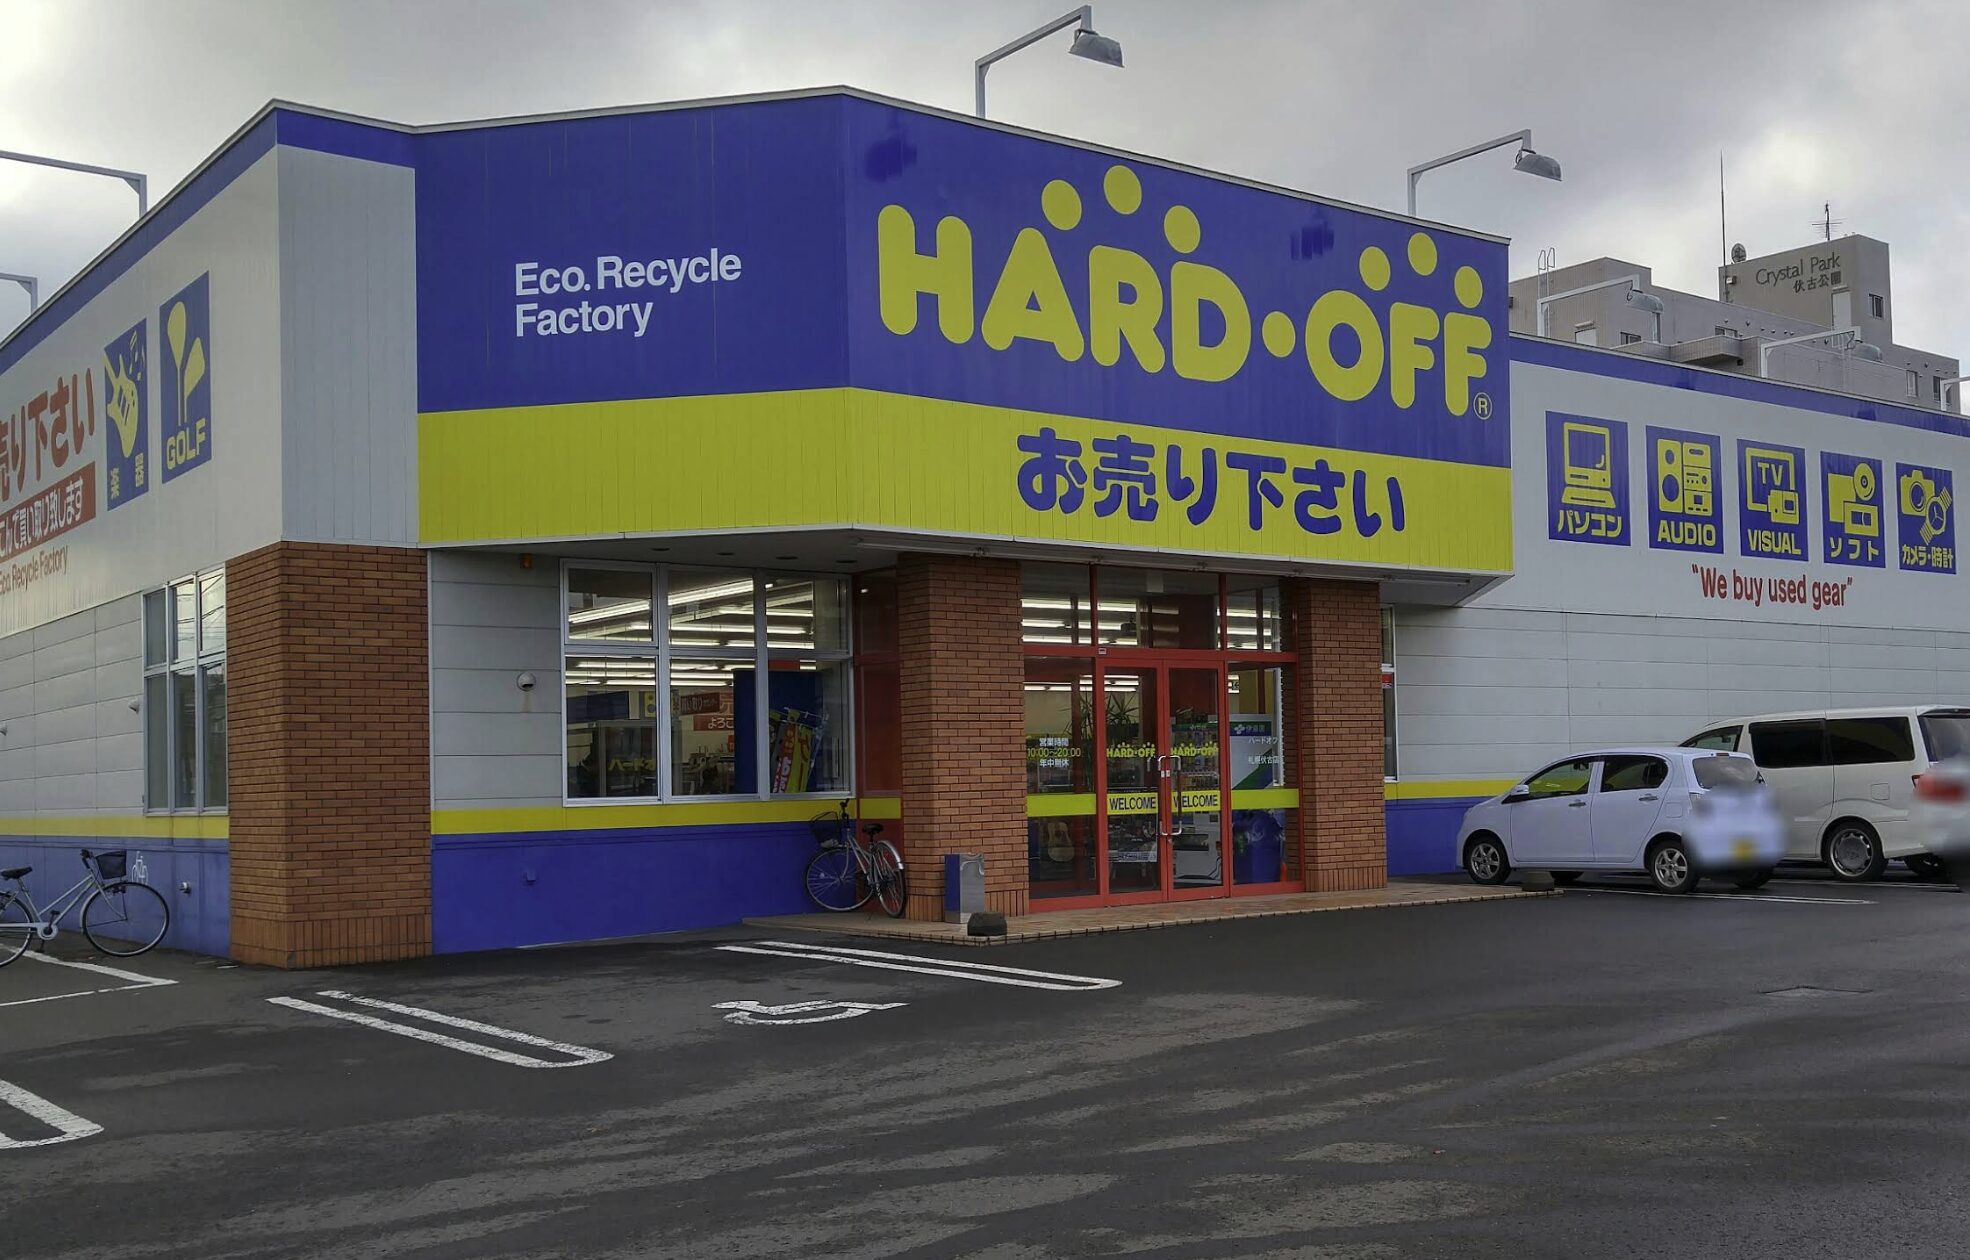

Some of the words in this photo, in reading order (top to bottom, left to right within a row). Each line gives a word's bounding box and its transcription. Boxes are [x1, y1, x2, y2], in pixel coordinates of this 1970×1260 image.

[515, 262, 591, 296] Eco.
[597, 248, 741, 293] Recycle
[1755, 259, 1804, 287] Crystal
[1810, 251, 1841, 274] Park
[1793, 271, 1842, 294] 伏古公園
[516, 301, 654, 337] Factory
[166, 417, 207, 470] GOLF
[1017, 427, 1405, 537] お売り下さい
[1758, 462, 1783, 487] TV
[1558, 509, 1623, 538] パソコン
[1657, 520, 1717, 548] AUDIO
[1747, 529, 1802, 556] VISUAL
[1829, 538, 1880, 562] ソフト
[1902, 544, 1954, 568] カメラ・時計
[12, 554, 39, 591] Recycle
[40, 544, 69, 578] Factory
[1733, 569, 1763, 606] buy
[1768, 577, 1807, 606] used
[1109, 796, 1156, 811] WELCOME
